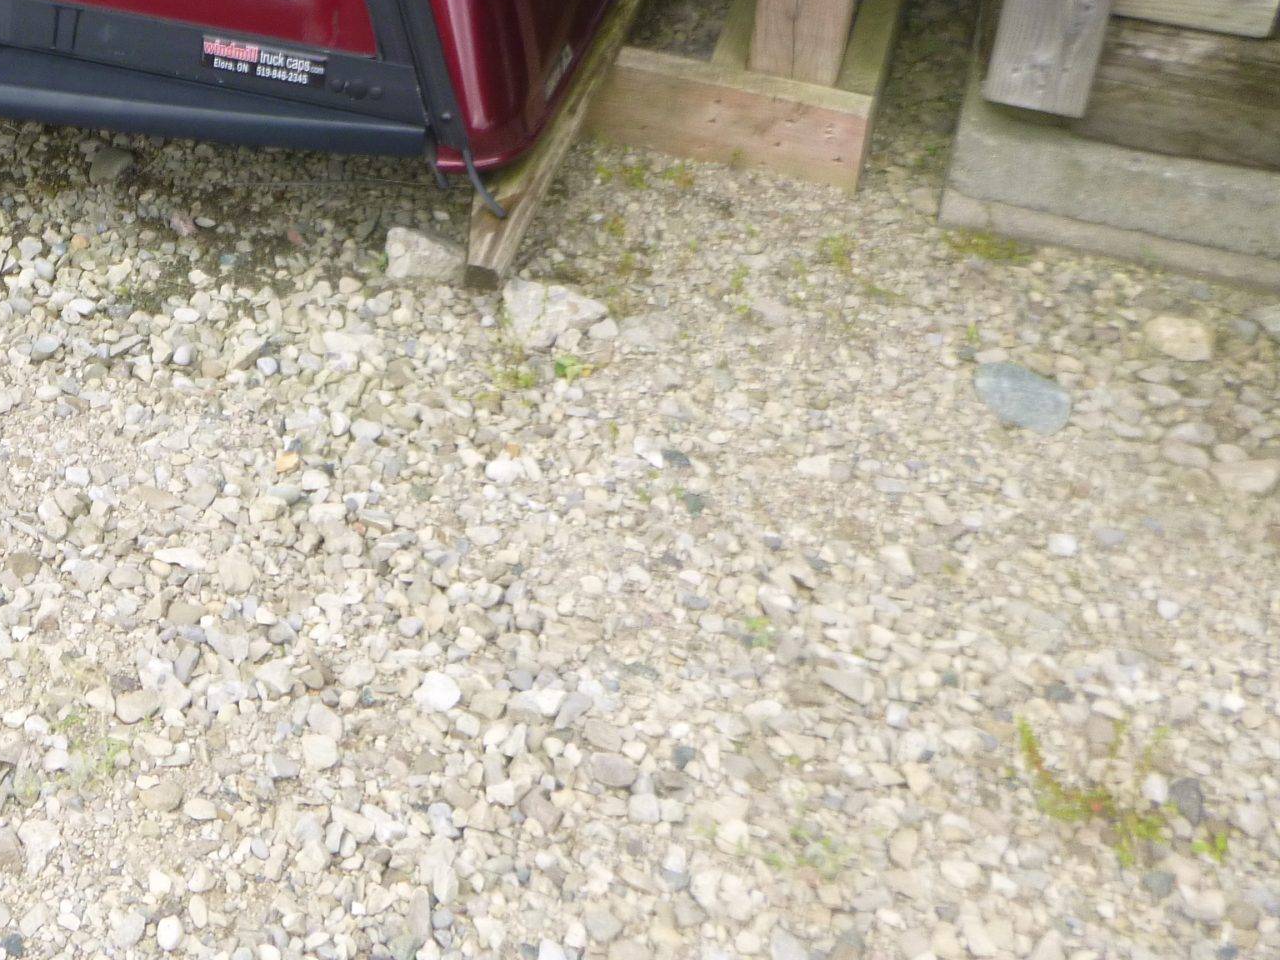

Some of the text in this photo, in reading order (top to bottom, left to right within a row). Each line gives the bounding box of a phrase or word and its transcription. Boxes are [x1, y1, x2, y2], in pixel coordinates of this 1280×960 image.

[204, 39, 259, 63] windmill
[260, 50, 284, 67] truck
[236, 61, 249, 74] ON
